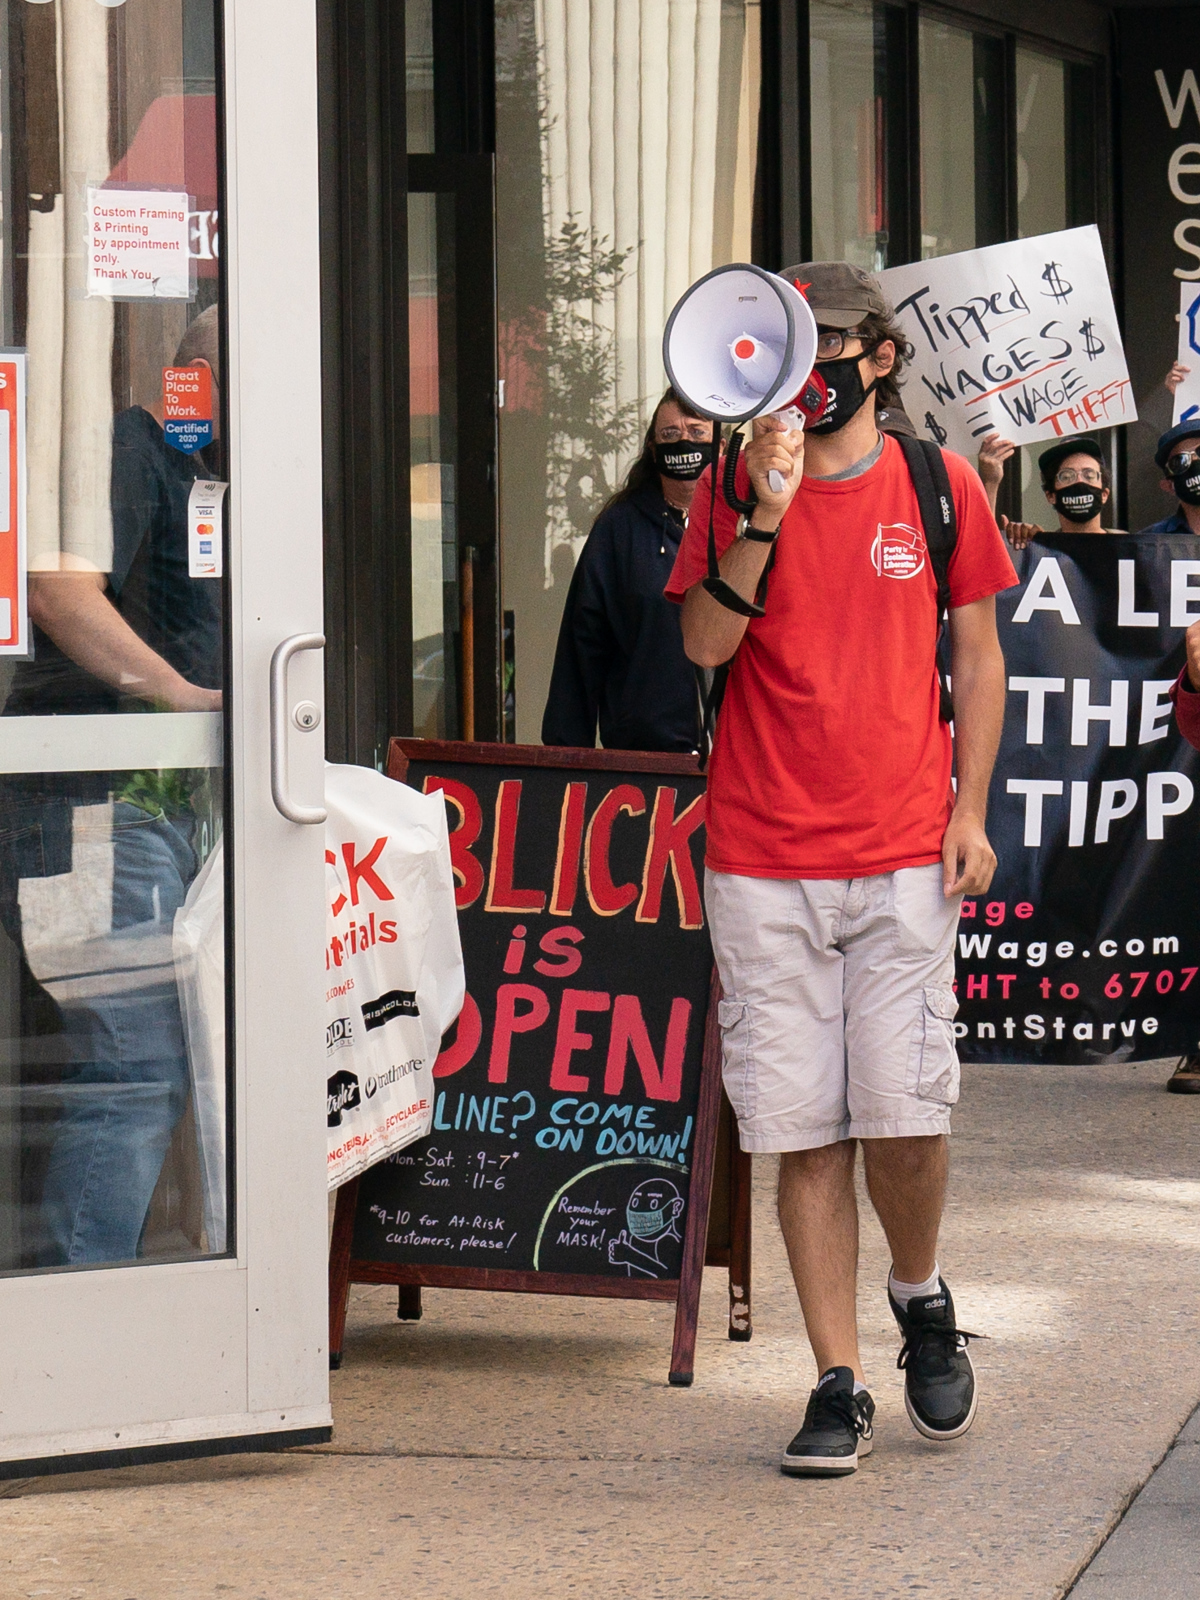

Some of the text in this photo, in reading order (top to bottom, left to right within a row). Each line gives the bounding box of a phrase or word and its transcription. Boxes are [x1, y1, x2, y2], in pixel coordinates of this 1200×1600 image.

[93, 206, 185, 222] Custom Framing
[93, 222, 149, 236] & Printing
[93, 237, 180, 251] by appointment
[93, 253, 120, 265] only.
[94, 267, 155, 280] Thank You.
[894, 260, 1073, 353] Tipped $
[921, 317, 1106, 407] WAGES $
[164, 370, 200, 381] Great
[165, 382, 199, 392] Place
[165, 393, 179, 404] To
[998, 367, 1088, 428] WAGE
[1038, 379, 1131, 437] THEFT
[166, 423, 209, 433] Certified
[178, 434, 198, 443] 2020
[664, 451, 703, 465] UNITED
[1062, 494, 1094, 505] UNITED
[1011, 557, 1082, 625] A
[1008, 676, 1177, 748] THE
[422, 775, 707, 930] BLICK
[1040, 977, 1080, 999] to
[431, 982, 692, 1103] OPEN
[433, 1090, 656, 1139] LINE? COME
[535, 1115, 693, 1164] ON DOWN!
[419, 1171, 451, 1187] Sun.
[558, 1196, 617, 1216] Remember
[419, 1214, 439, 1227] for
[448, 1214, 506, 1231] At-Risk
[569, 1216, 600, 1230] your
[385, 1229, 518, 1254] customers, please!
[556, 1228, 606, 1251] MASK!
